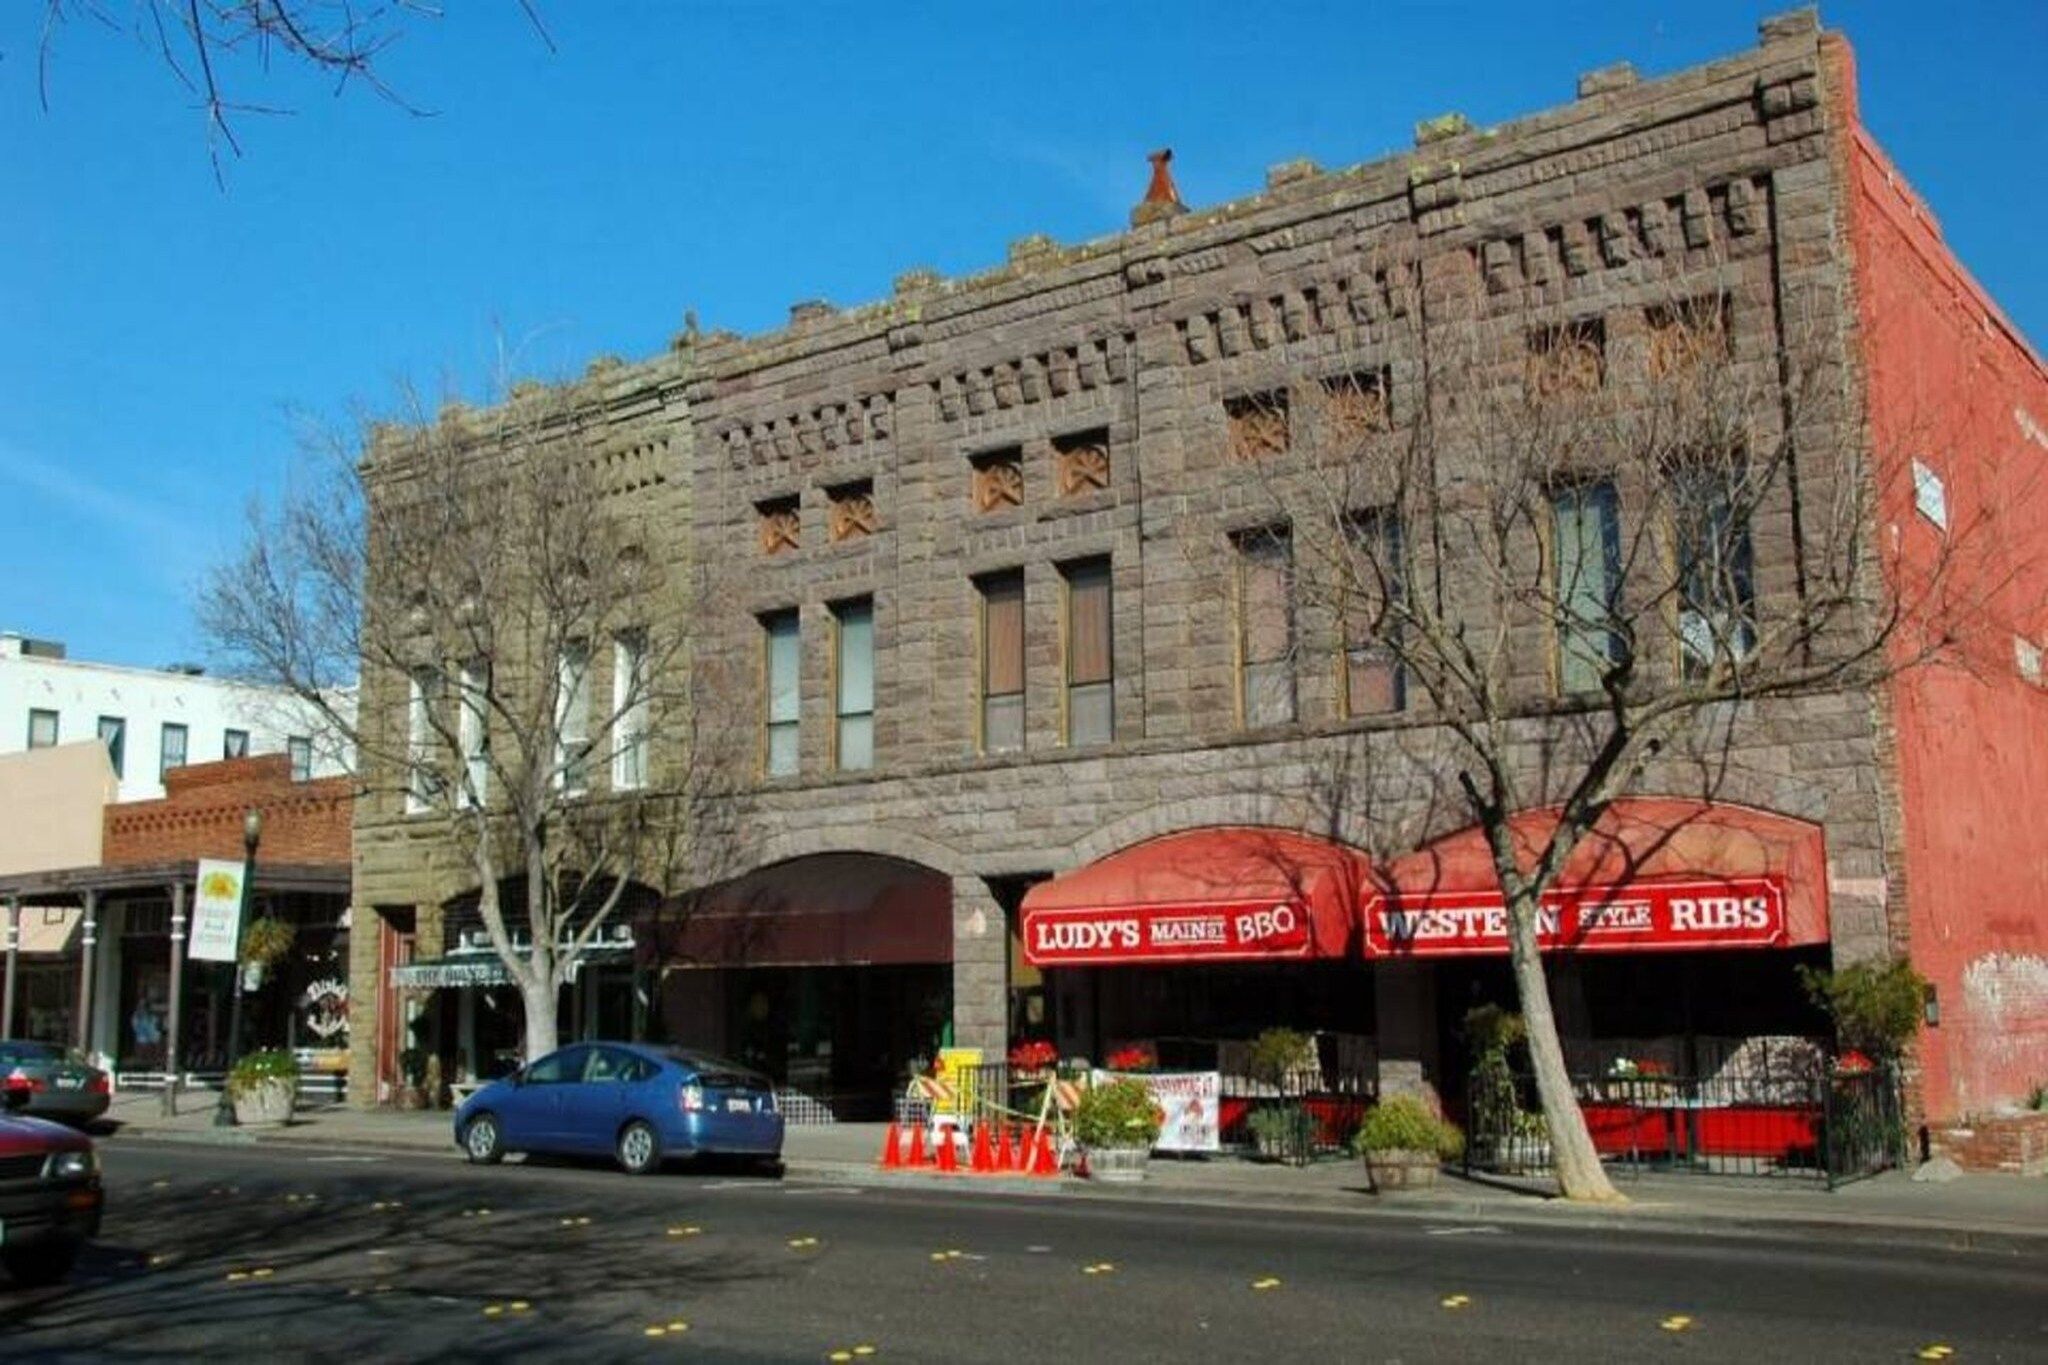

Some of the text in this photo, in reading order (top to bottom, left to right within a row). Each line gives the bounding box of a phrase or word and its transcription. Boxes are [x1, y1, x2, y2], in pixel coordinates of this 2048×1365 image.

[1036, 919, 1142, 951] LUDY'S
[1150, 920, 1206, 942] MAIN
[1235, 904, 1296, 944] BBQ
[1378, 896, 1770, 940] WESTEN STYLE RIBS
